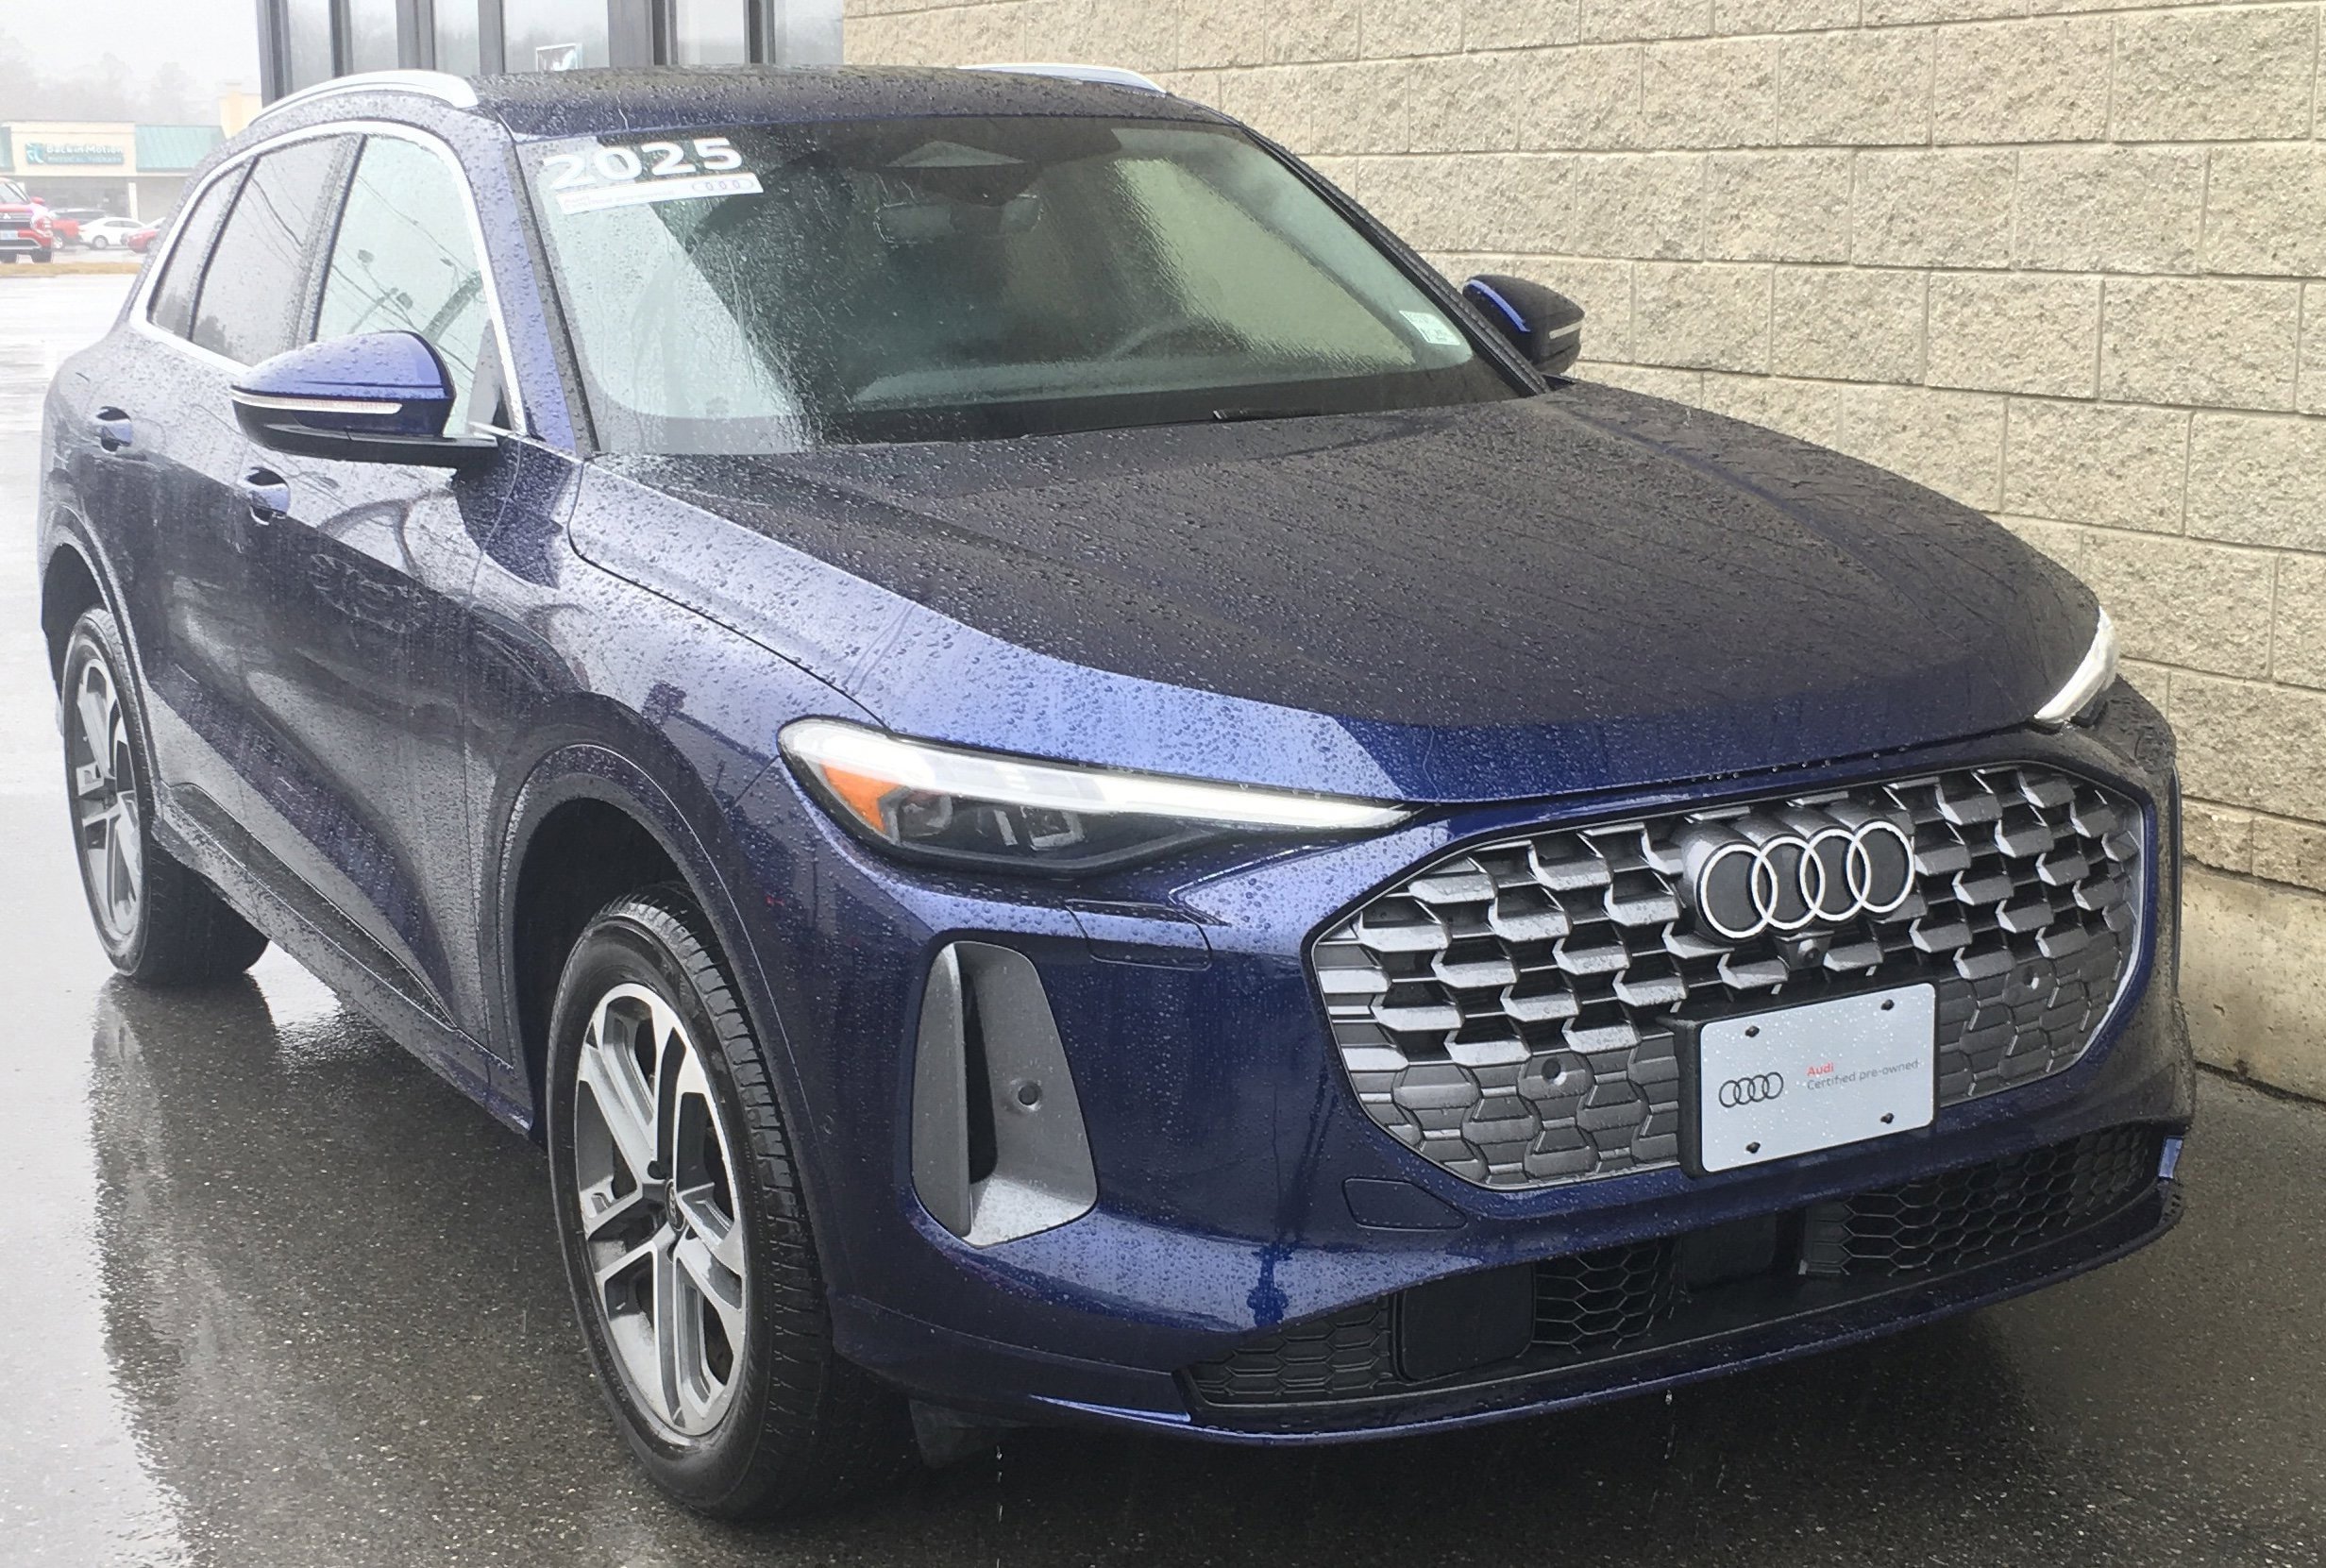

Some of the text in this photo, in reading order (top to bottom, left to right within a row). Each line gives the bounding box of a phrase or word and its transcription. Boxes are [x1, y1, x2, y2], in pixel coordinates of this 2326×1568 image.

[543, 137, 743, 190] 2025
[1807, 1062, 1834, 1076] Audi
[1807, 1058, 1919, 1090] Certified pre-owned
